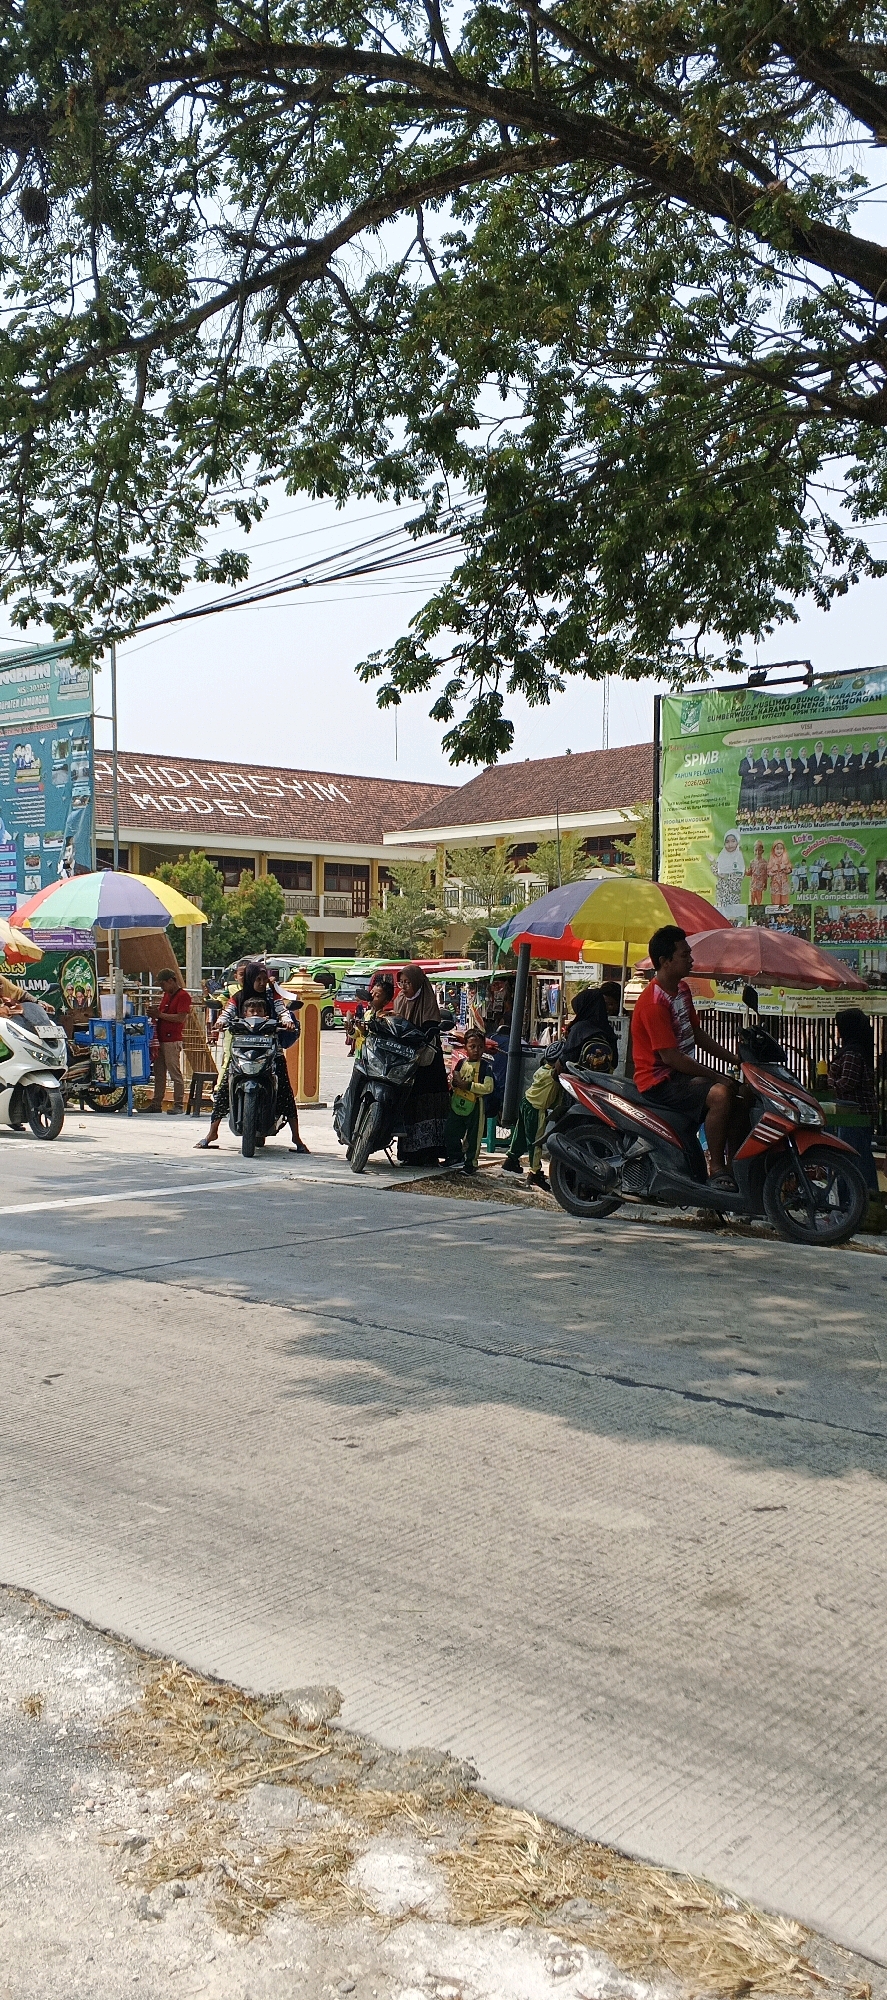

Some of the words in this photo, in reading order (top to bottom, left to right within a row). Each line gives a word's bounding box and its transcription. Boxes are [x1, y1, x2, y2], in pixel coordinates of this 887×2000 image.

[707, 709, 755, 722] SUMBERWUDI
[831, 694, 883, 706] LAMONGAN
[753, 697, 793, 709] MUSLIMAT
[796, 696, 826, 704] BUNGA
[684, 751, 719, 768] SPMB
[675, 771, 694, 779] TAHUN
[694, 768, 724, 777] PELAJARAN
[684, 816, 710, 824] UNGGULAN
[814, 821, 840, 829] Muslimat
[841, 820, 860, 828] Bunga
